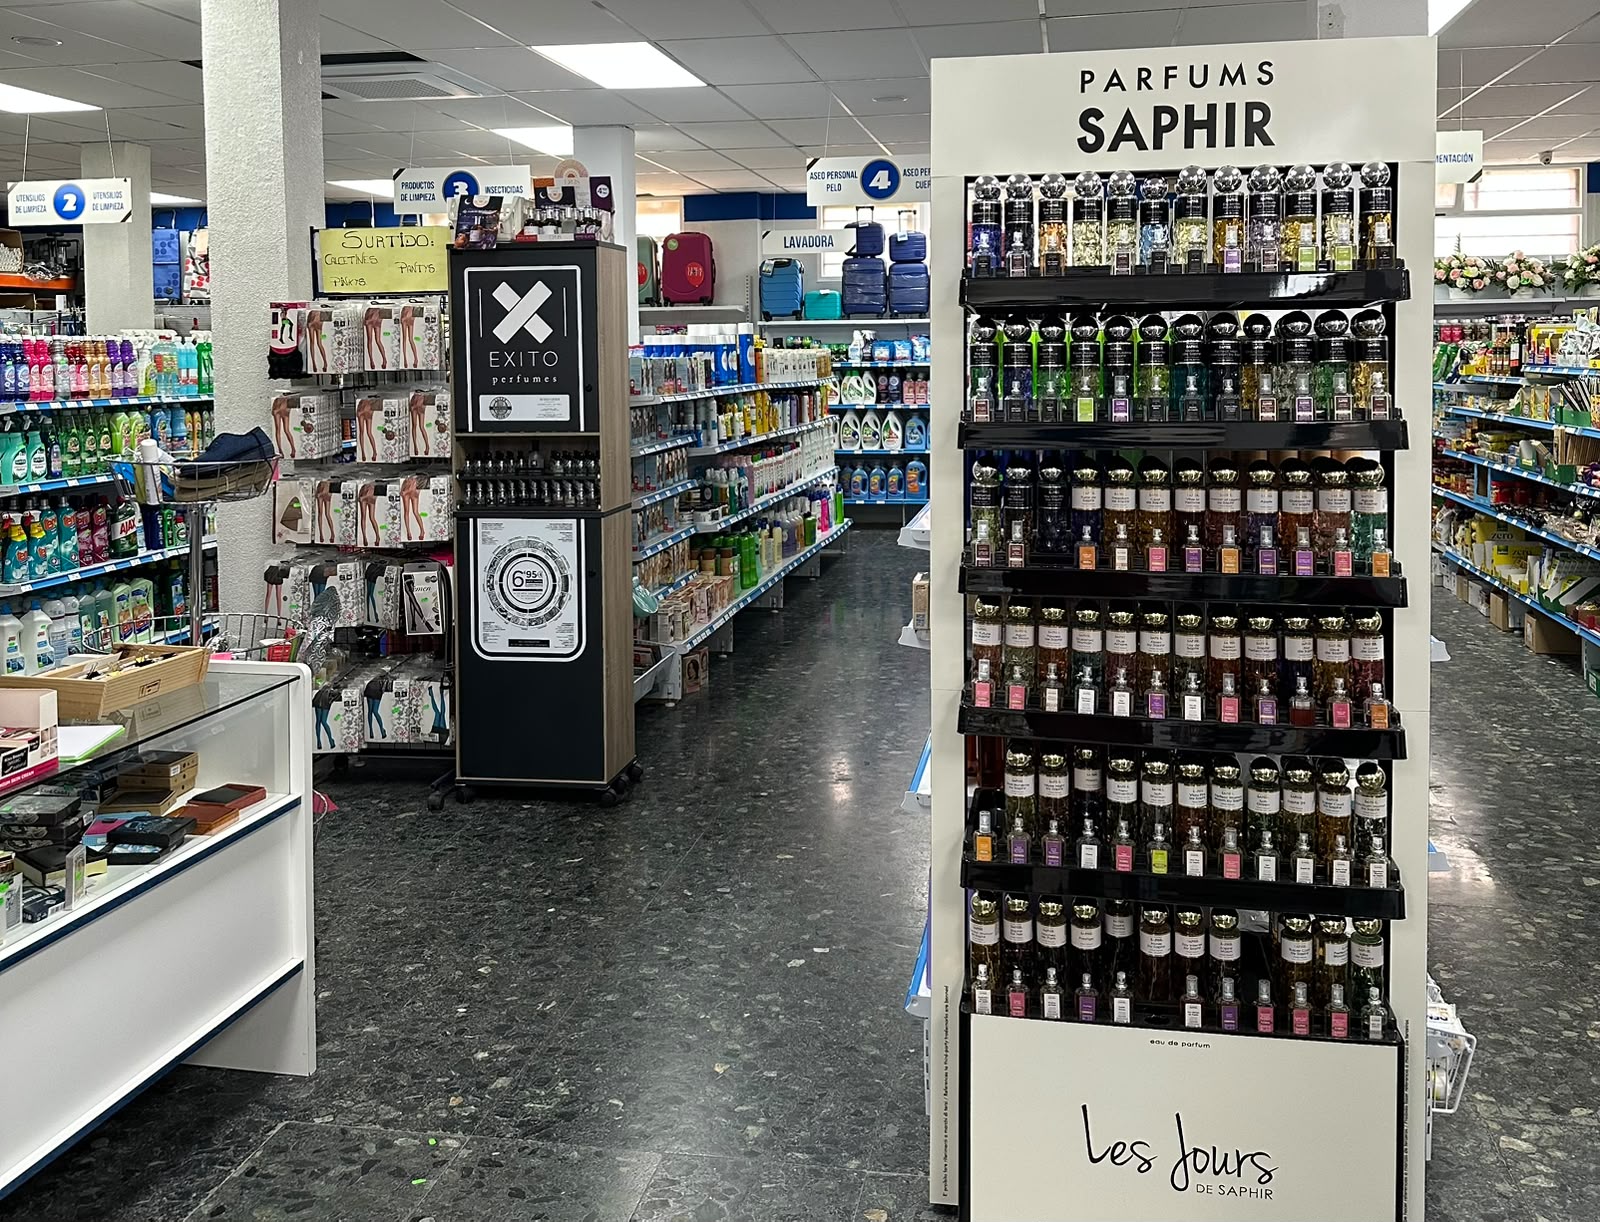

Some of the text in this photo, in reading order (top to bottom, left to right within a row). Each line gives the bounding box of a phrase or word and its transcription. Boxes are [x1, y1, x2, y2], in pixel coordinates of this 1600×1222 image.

[1080, 60, 1274, 94] PARFUMS
[1076, 101, 1275, 154] SAPHIR
[809, 170, 858, 180] ASEO PERSONAL
[902, 168, 919, 177] ASEO
[401, 181, 435, 190] PRODUCTOS
[869, 170, 891, 190] 4
[452, 181, 469, 197] 3
[484, 185, 524, 194] INSECTICIDAS
[826, 183, 842, 192] PELO
[15, 194, 46, 202] UTENSILIOS
[92, 191, 123, 200] UTENSILIOS
[400, 193, 436, 202] DE LIMPIEZA
[62, 193, 77, 212] 2
[92, 202, 124, 211] DE LIMPIEZA
[15, 203, 47, 214] DE LIMPIEZA
[783, 234, 834, 249] LAVADORA
[489, 350, 559, 368] EXITO
[492, 373, 558, 386] perfumes
[119, 516, 136, 536] AJAX
[1491, 532, 1513, 540] zero
[1181, 1041, 1211, 1049] parfum
[1081, 1103, 1280, 1192] Les Jours
[1196, 1183, 1274, 1200] DE SAPHIR
